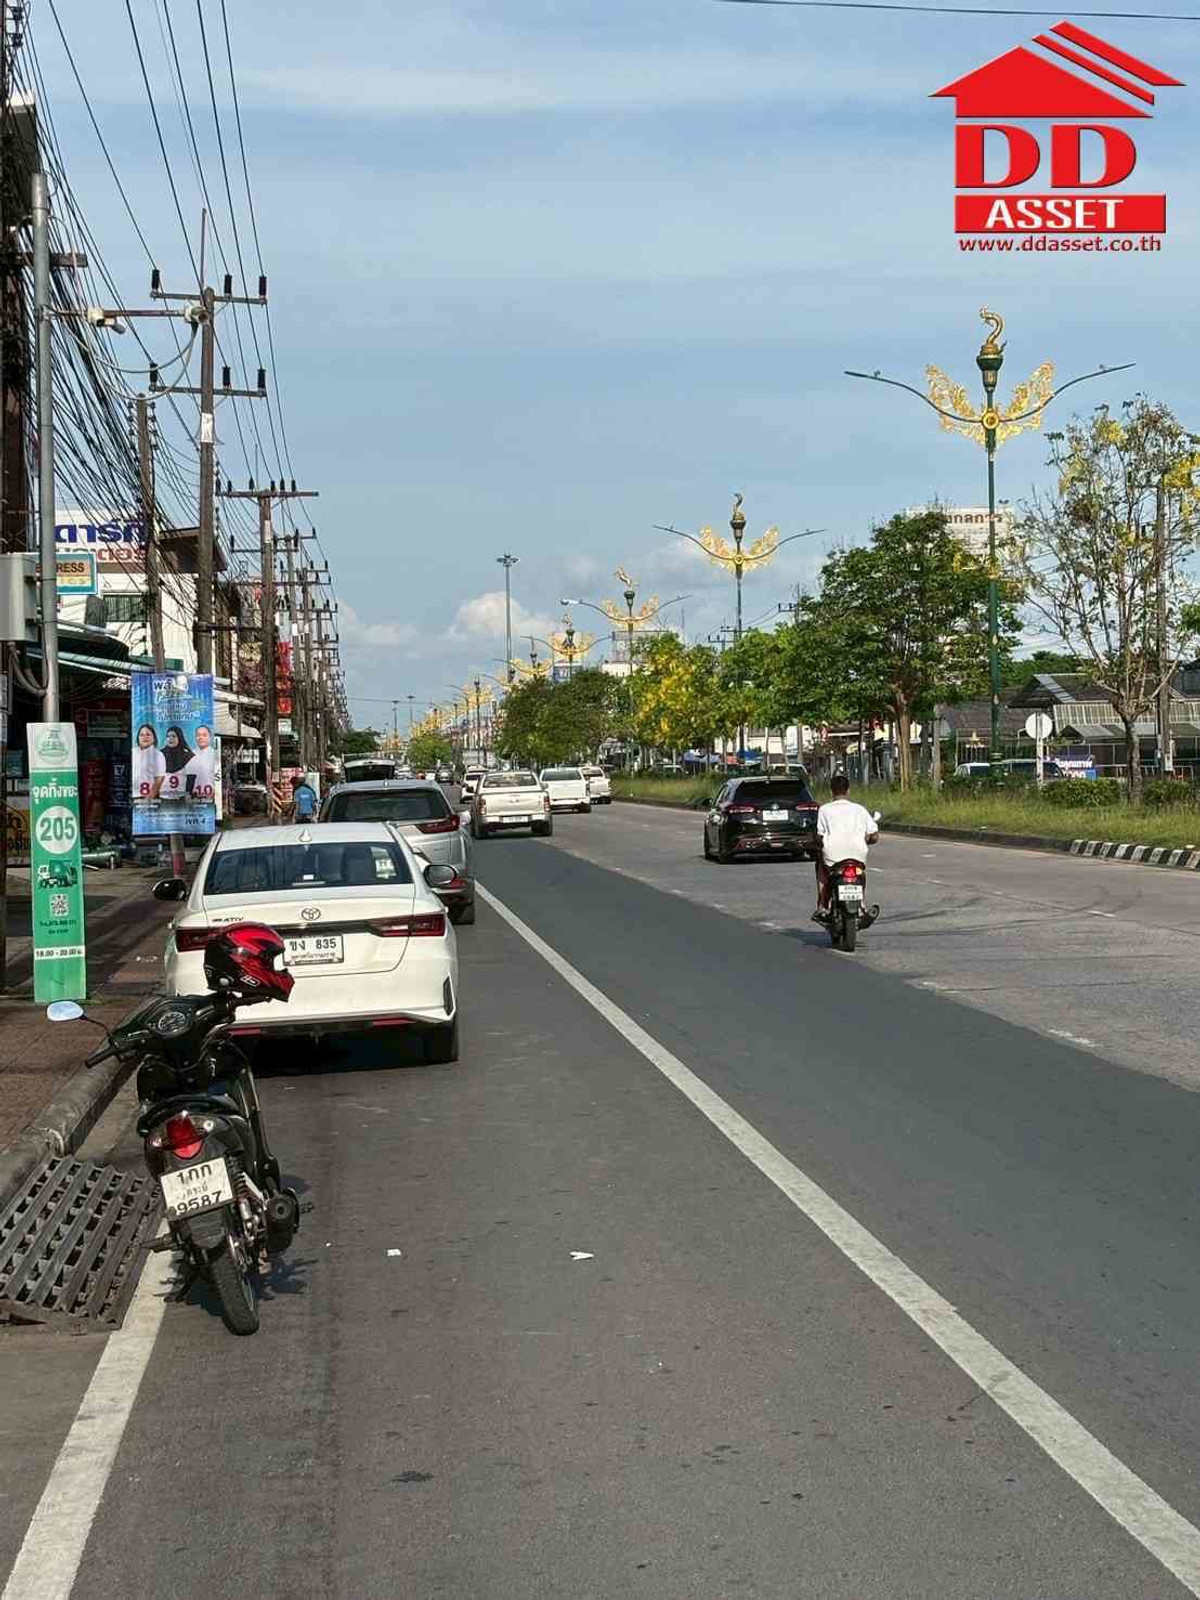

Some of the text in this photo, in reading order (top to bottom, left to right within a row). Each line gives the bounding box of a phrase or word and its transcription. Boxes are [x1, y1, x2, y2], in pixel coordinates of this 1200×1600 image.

[140, 782, 150, 796] 8
[169, 775, 179, 788] 9
[32, 777, 78, 805] จุดทิ้งขยะ
[194, 785, 213, 797] 10
[40, 817, 75, 841] 205
[316, 937, 336, 949] 835
[176, 1164, 212, 1185] 1กก
[176, 1190, 222, 1214] 9587
